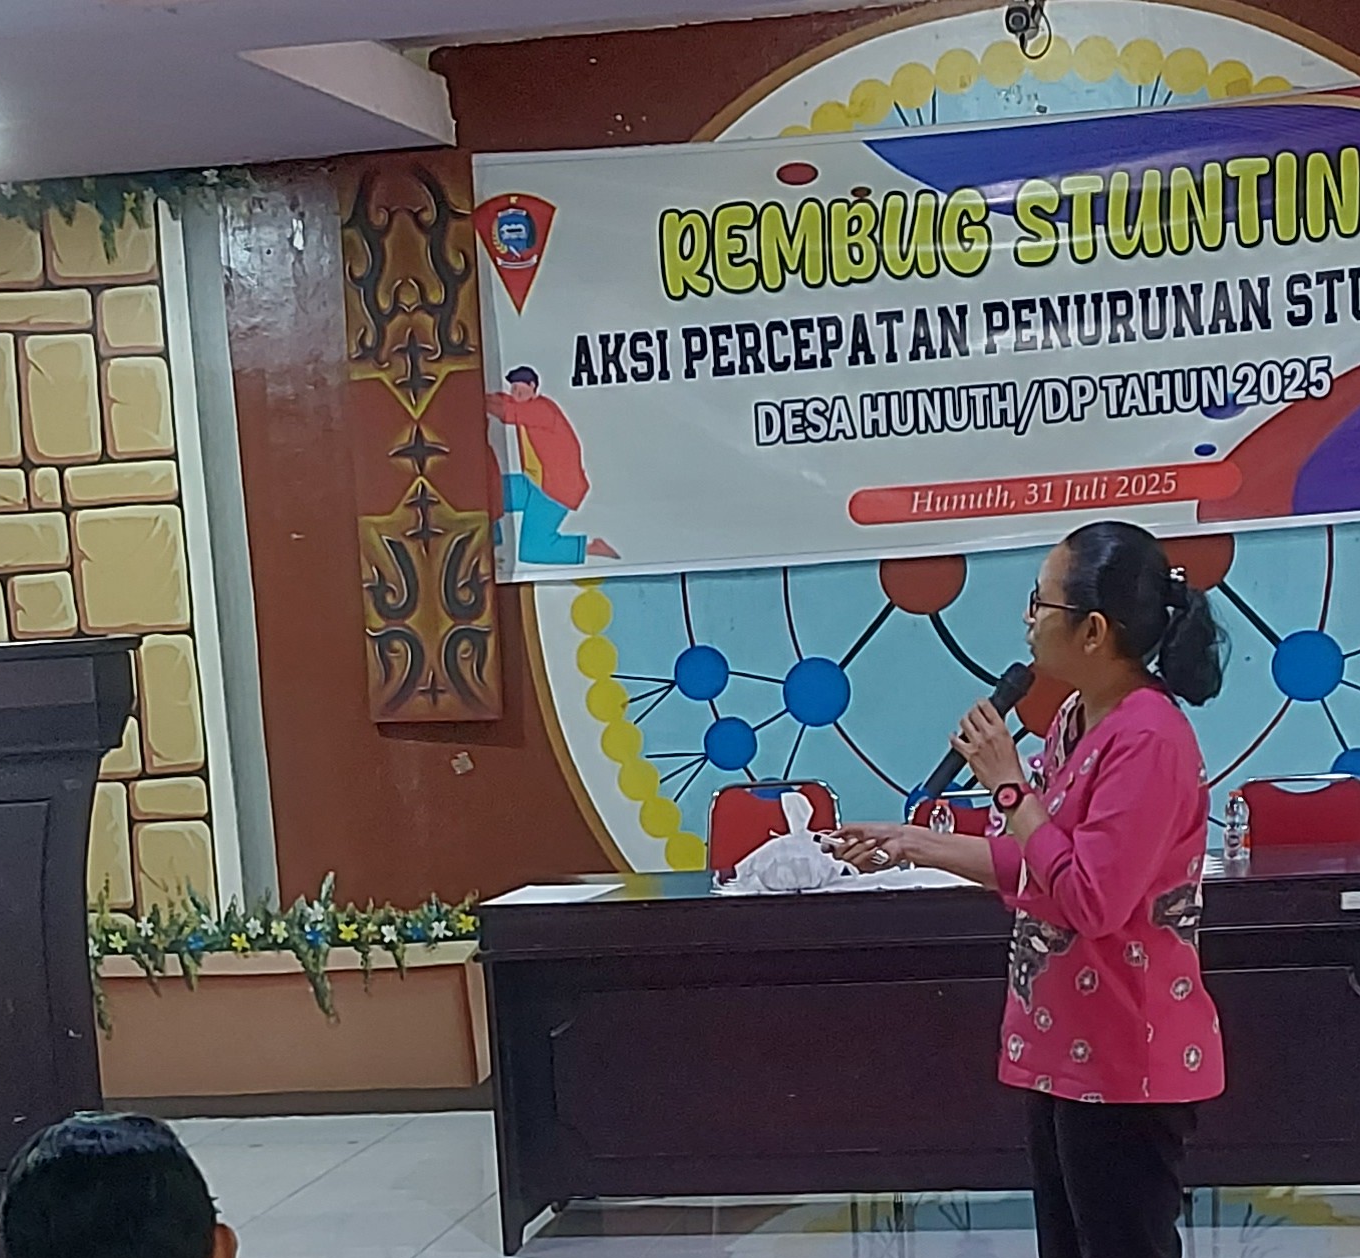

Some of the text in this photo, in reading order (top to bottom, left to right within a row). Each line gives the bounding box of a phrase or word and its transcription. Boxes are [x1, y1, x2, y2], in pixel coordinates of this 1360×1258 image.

[659, 187, 991, 300] REMBUG
[572, 329, 672, 387] AKSI
[683, 304, 969, 380] PERCEPATAN
[982, 277, 1271, 354] PENURUNAN
[755, 355, 1332, 446] DESA HUNUTH/DP TAHUN 2025
[911, 472, 1177, 513] Hunuth, 31 Juli 2025
